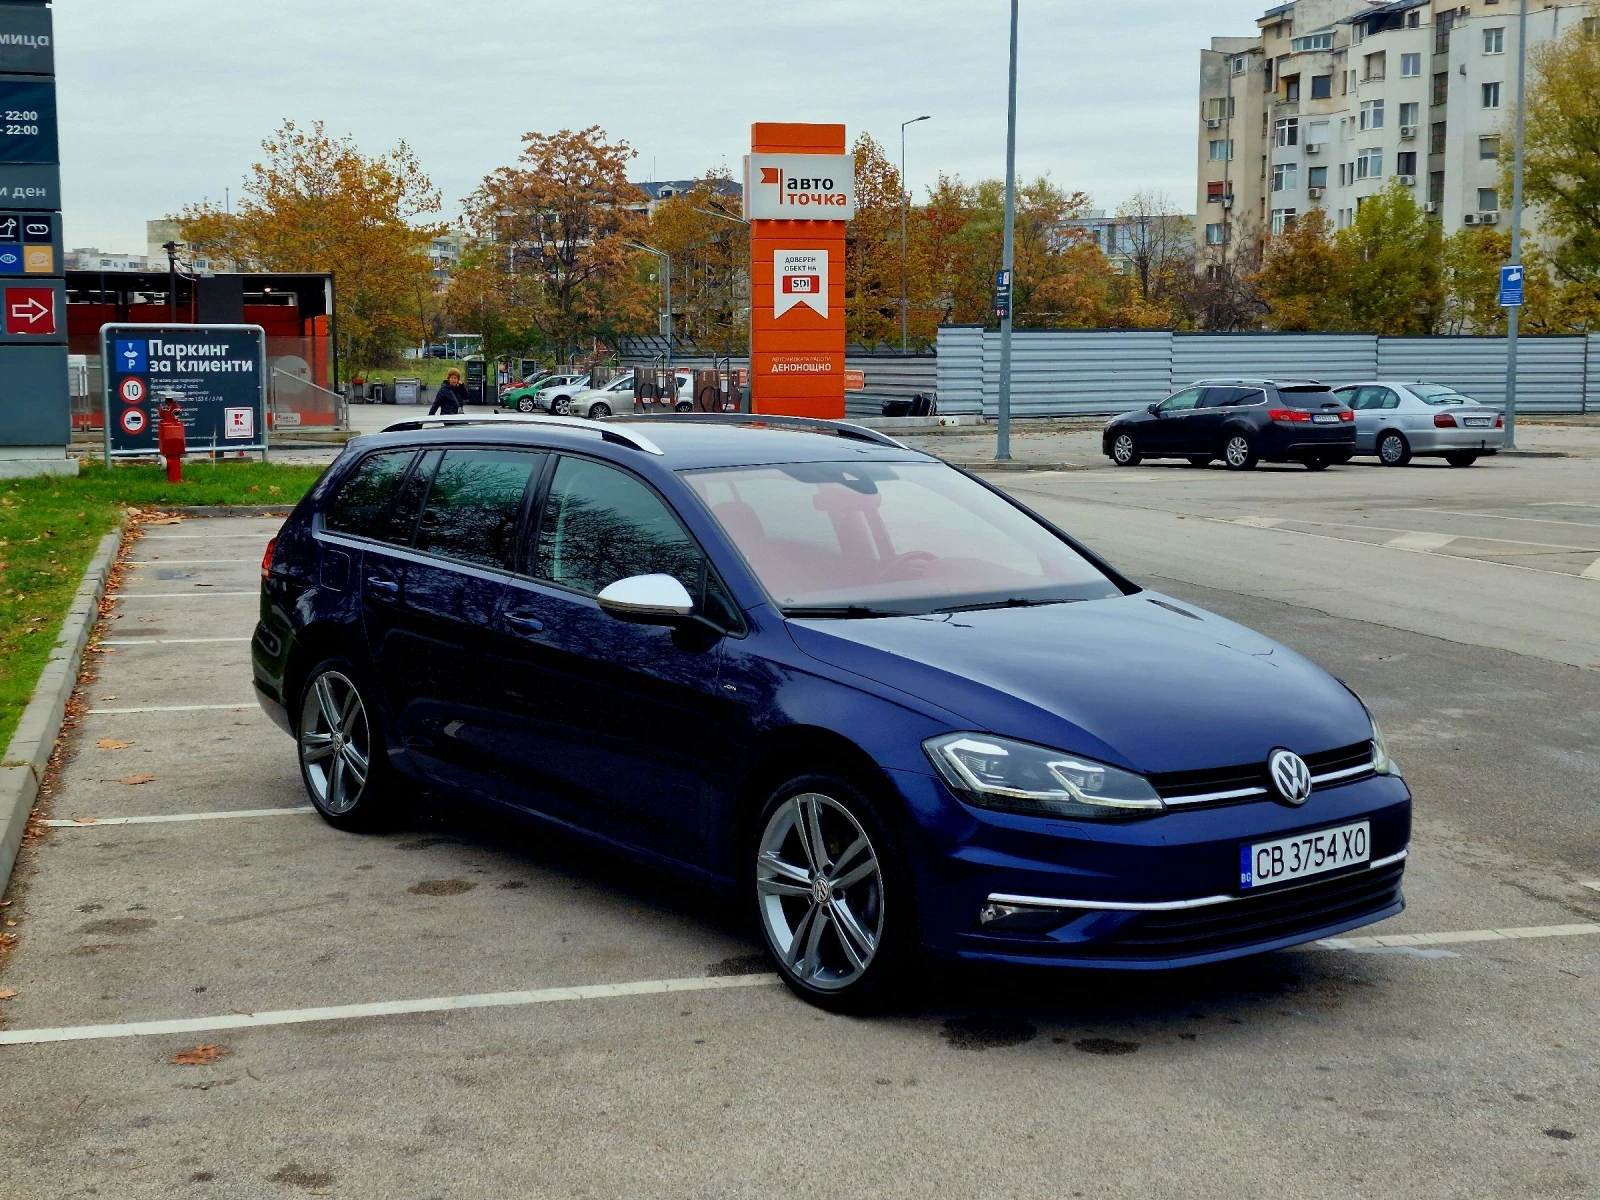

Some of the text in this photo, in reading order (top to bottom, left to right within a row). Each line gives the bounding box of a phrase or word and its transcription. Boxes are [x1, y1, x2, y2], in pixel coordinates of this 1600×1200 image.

[5, 110, 38, 121] 22:00
[6, 125, 39, 135] 22:00
[787, 177, 834, 190] авто
[12, 187, 46, 199] ден
[787, 193, 847, 206] точка
[785, 256, 816, 264] ДОВЕРЕН
[792, 279, 810, 288] SDI
[149, 339, 229, 360] Паркинг
[128, 359, 136, 369] P
[149, 359, 253, 372] за клиенти
[771, 363, 832, 373] ДЕНОНОЩНО
[126, 384, 139, 397] 10
[1256, 827, 1366, 880] CB 3754 XO
[1240, 872, 1251, 883] BG
